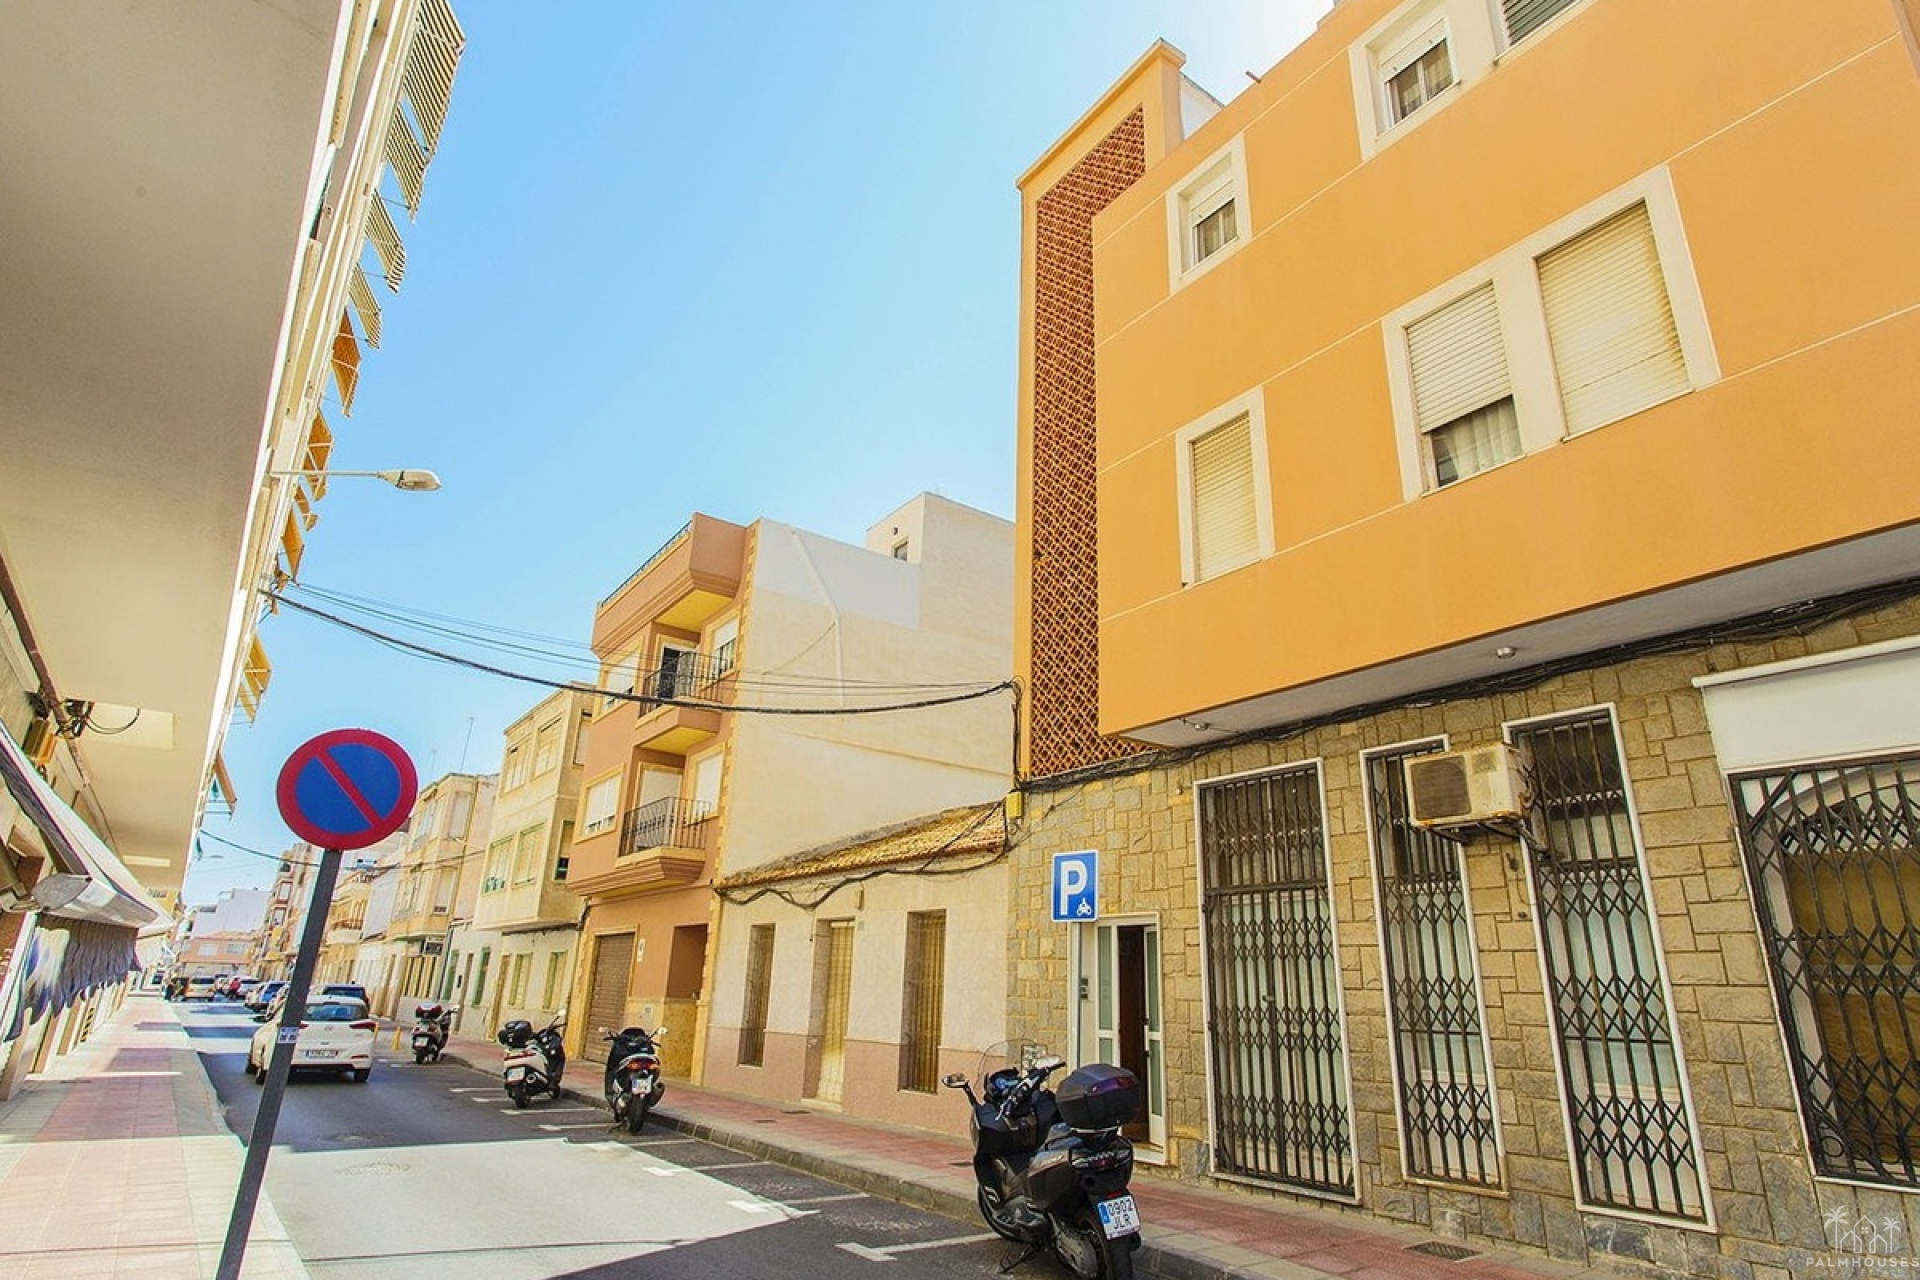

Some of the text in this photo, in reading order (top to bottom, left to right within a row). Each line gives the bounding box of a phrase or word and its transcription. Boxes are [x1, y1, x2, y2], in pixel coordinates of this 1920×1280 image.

[1060, 860, 1087, 916] P
[1108, 1199, 1133, 1217] 0902
[1113, 1213, 1132, 1230] JLR
